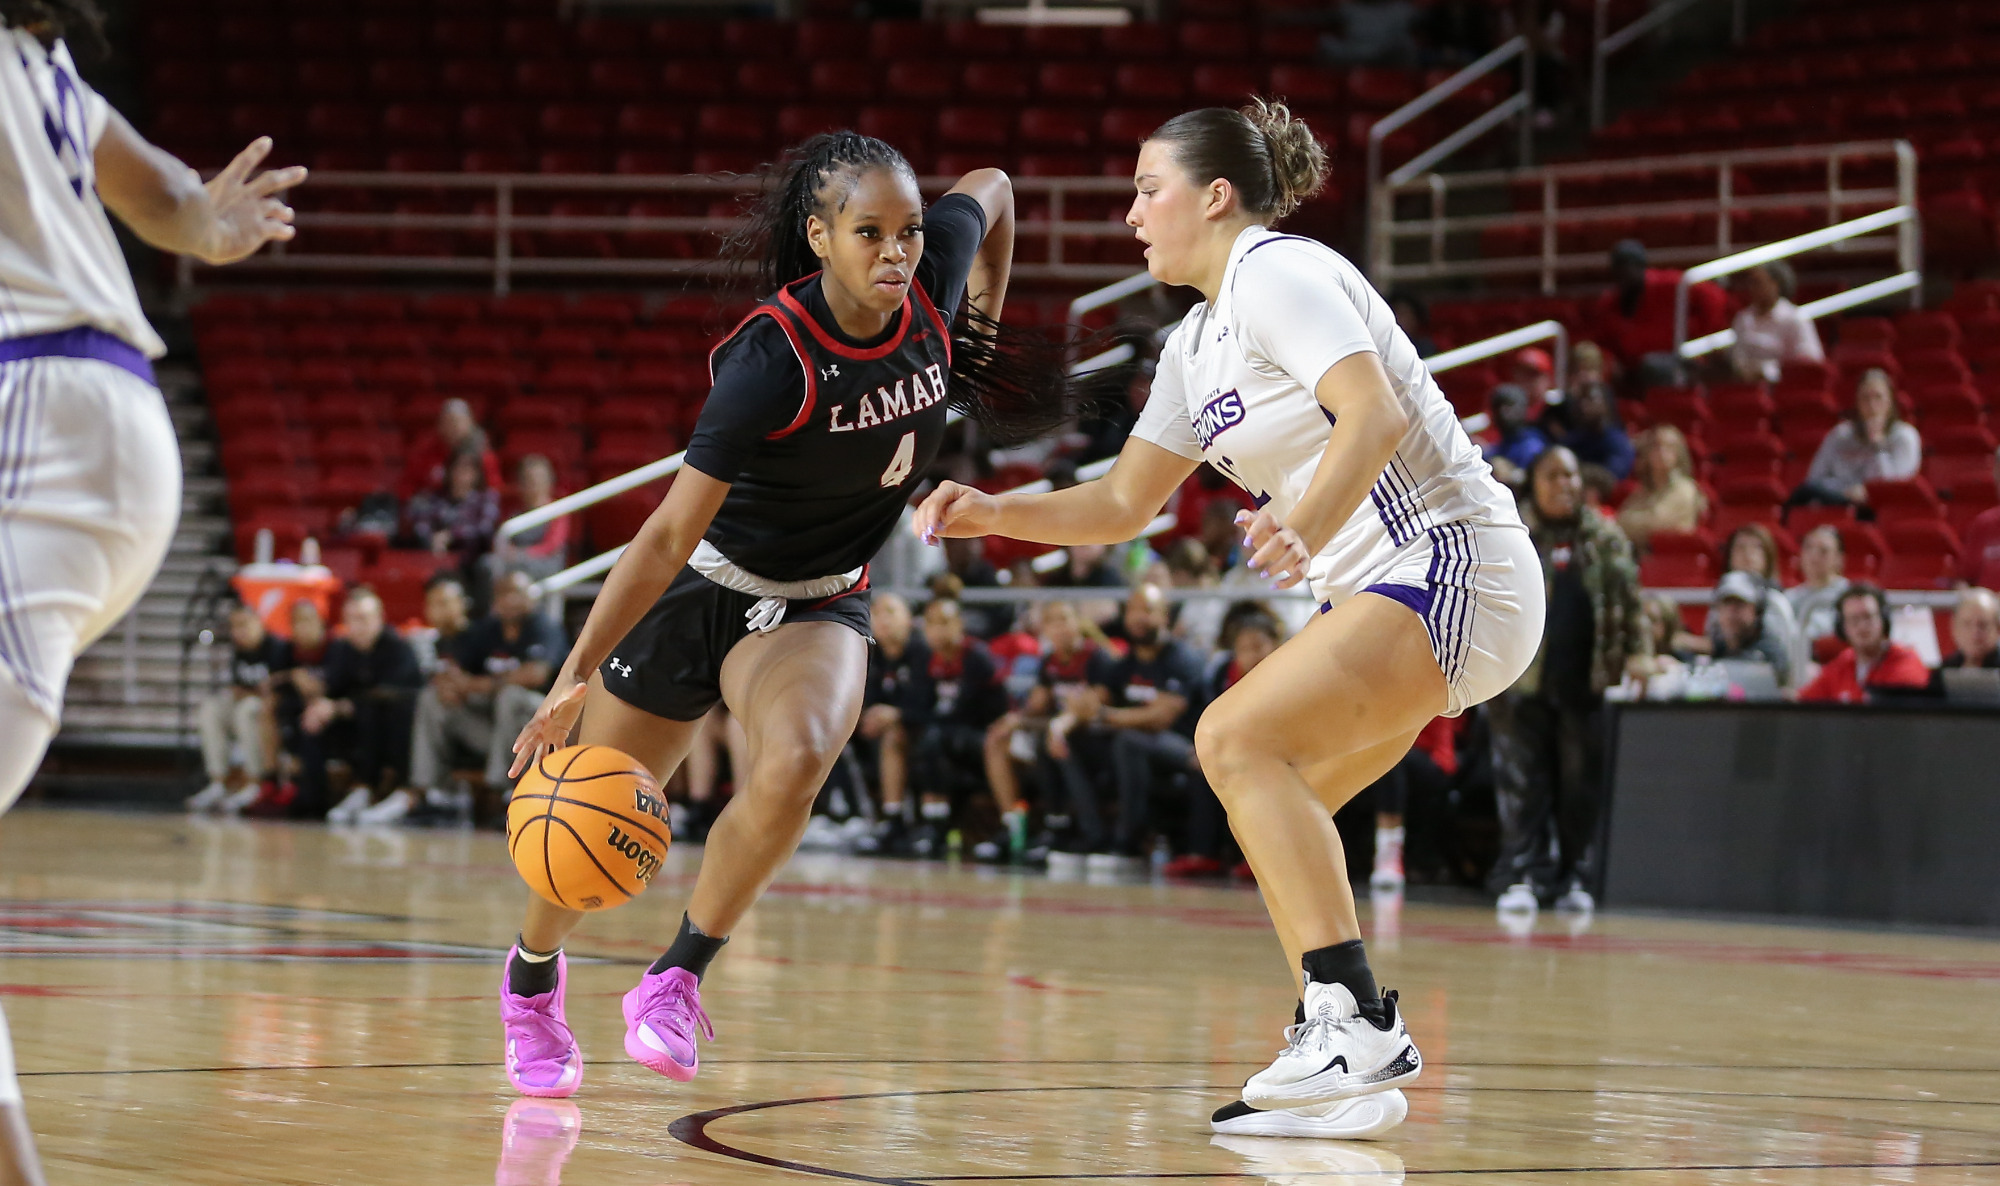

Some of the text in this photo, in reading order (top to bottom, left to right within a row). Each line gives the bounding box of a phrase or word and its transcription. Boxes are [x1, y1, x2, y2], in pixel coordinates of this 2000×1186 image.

[829, 362, 946, 433] LAMAR
[881, 431, 915, 488] 4
[635, 788, 672, 830] CAA
[607, 825, 662, 887] ilson
